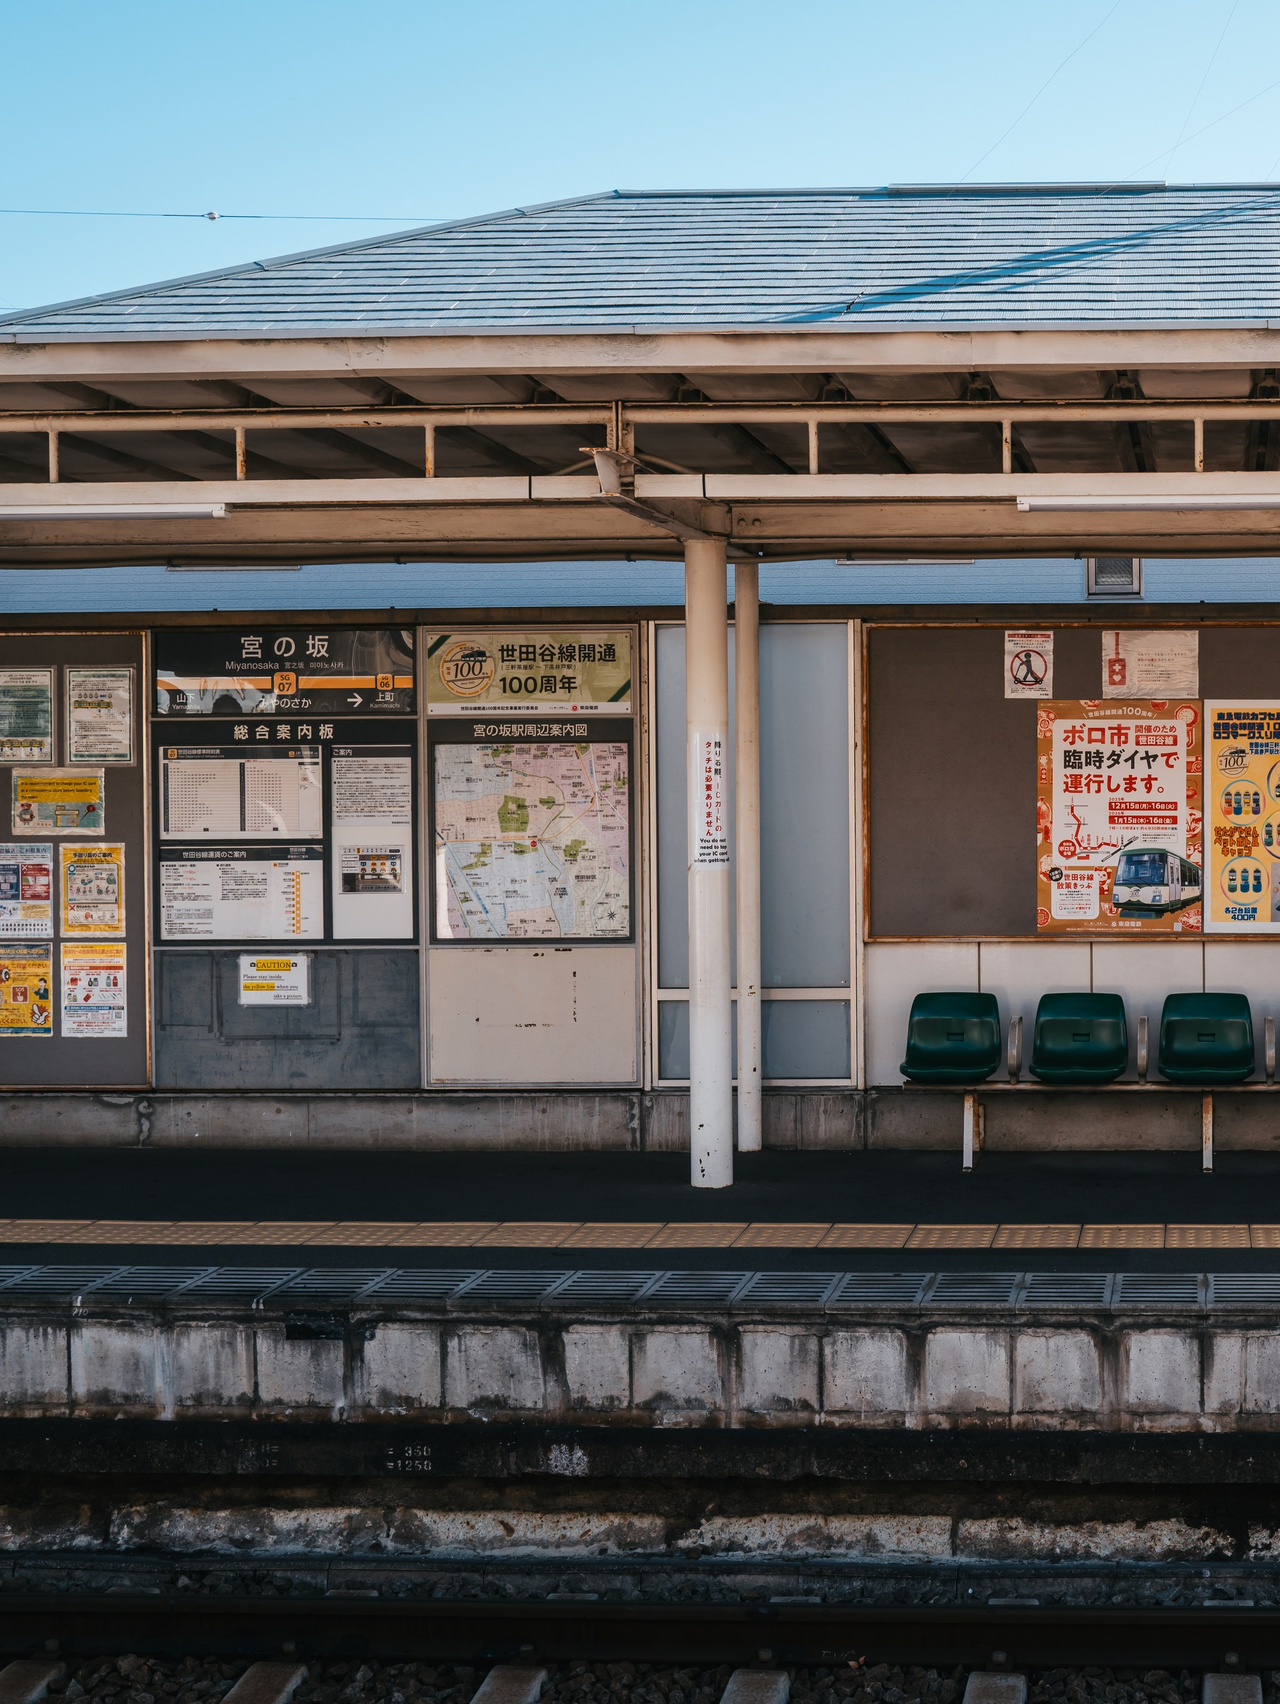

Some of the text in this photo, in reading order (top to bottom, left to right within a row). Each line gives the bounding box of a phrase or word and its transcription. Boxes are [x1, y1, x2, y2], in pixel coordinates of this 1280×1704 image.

[241, 635, 329, 658] 宮の坂
[498, 644, 616, 662] 世田谷線開通
[225, 661, 279, 670] Miyanosaka
[453, 661, 483, 679] 100
[278, 683, 292, 691] 07
[499, 675, 578, 694] 100周年
[176, 694, 195, 702] 山下
[376, 692, 394, 701] 上町
[259, 698, 312, 708] みやのさか
[234, 724, 334, 740] 総合案内板
[473, 724, 588, 737] 宮の坂駅周辺案内図
[1135, 725, 1177, 733] 開催のため
[1063, 723, 1131, 746] ボロ市
[1139, 736, 1174, 745] 世田谷線
[1063, 749, 1180, 770] 臨時ダイヤで
[1063, 773, 1165, 794] 運行します。
[705, 741, 713, 837] タッチは必要ありません
[1214, 826, 1259, 837] せたがやせん
[1214, 837, 1259, 847] ペットボトル
[1221, 847, 1252, 857] キャップ
[1064, 873, 1094, 881] 世田谷線
[1056, 882, 1094, 890] 散策きっぷ
